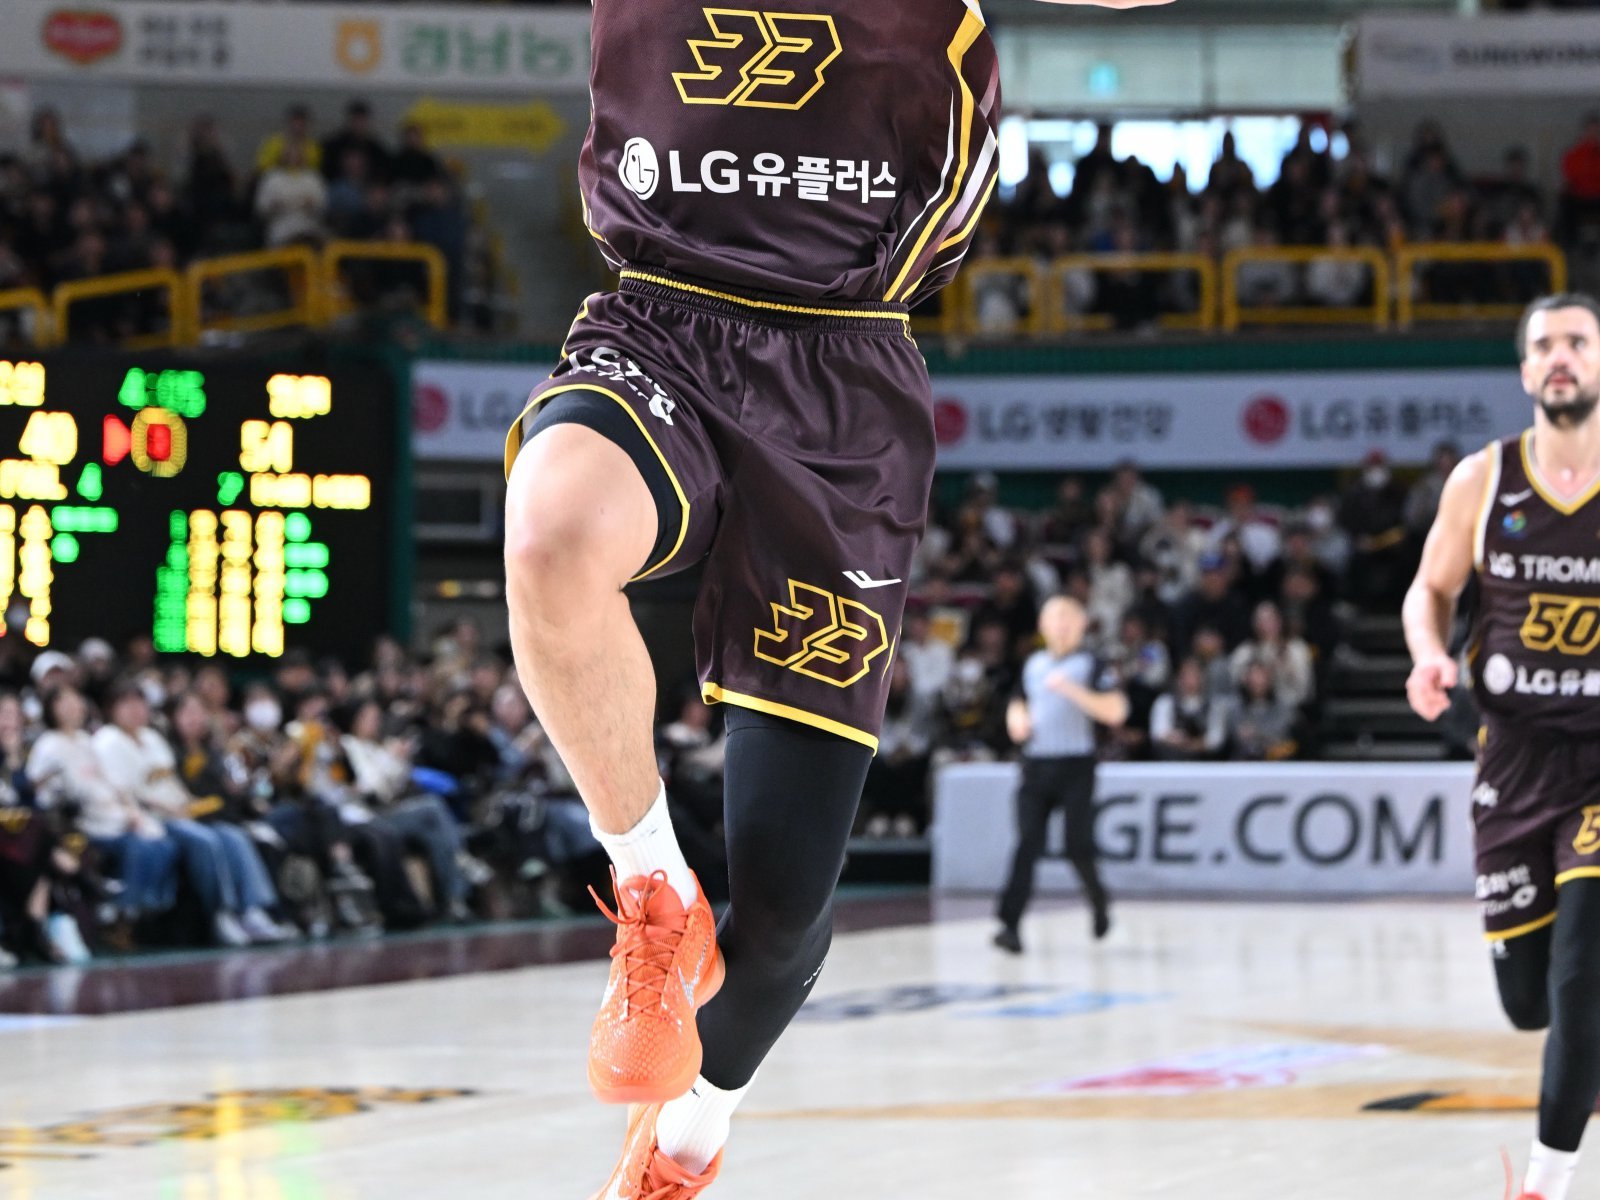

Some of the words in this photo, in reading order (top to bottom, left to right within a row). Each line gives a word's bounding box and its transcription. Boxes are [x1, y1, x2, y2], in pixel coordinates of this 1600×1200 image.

[672, 7, 843, 111] 33
[668, 149, 897, 204] LG유플러스
[754, 578, 889, 689] 33
[1519, 592, 1600, 656] 50
[1045, 792, 1446, 865] GE.COM
